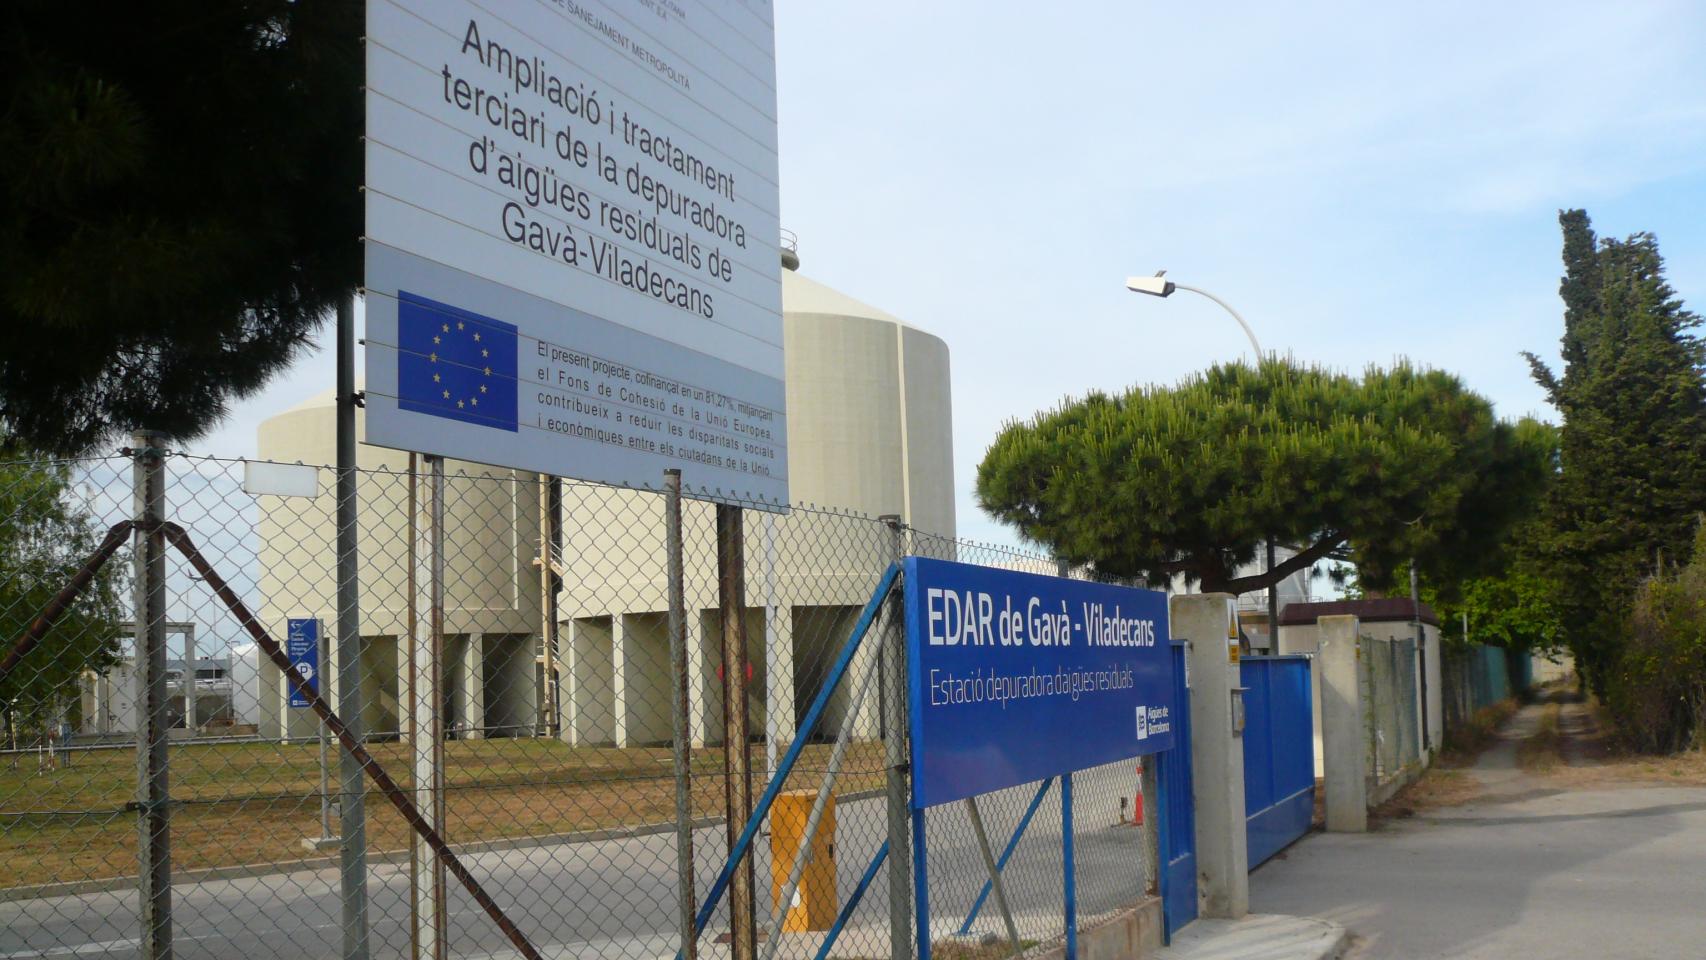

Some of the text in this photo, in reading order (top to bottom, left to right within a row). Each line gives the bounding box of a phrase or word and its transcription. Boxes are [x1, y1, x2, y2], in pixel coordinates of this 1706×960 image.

[567, 0, 630, 48] SANEJAMENT
[461, 19, 736, 202] Ampliació i tractament
[442, 64, 747, 249] terciari de la depuradora
[469, 136, 732, 282] d'aigües residuals de
[502, 202, 714, 318] Gavà-Viladecans
[537, 340, 549, 357] El
[551, 348, 590, 369] present
[592, 360, 632, 382] projecte,
[635, 371, 679, 396] cofinançat
[681, 386, 692, 398] en
[693, 390, 704, 401] un
[737, 402, 773, 422] mitjançant
[537, 367, 549, 381] el
[558, 370, 589, 392] Fons
[597, 382, 612, 398] de
[619, 387, 666, 412] Cohesió
[672, 402, 685, 417] de
[691, 406, 700, 421] la
[706, 411, 729, 429] Unió
[537, 392, 775, 459] contribueix a reduir les disparitats socials
[538, 412, 542, 427] i
[547, 418, 624, 445] econòmiques
[628, 435, 655, 451] entre
[660, 441, 674, 456] els
[678, 446, 722, 466] ciutadans
[726, 457, 737, 469] de
[740, 459, 748, 472] la
[928, 588, 994, 646] EDAR
[1000, 595, 1023, 646] de
[1027, 596, 1070, 647] Gavà
[1083, 601, 1155, 647] Viladecans
[930, 664, 984, 706] Estació
[986, 665, 1053, 710] depuradora
[1095, 663, 1133, 691] residuals
